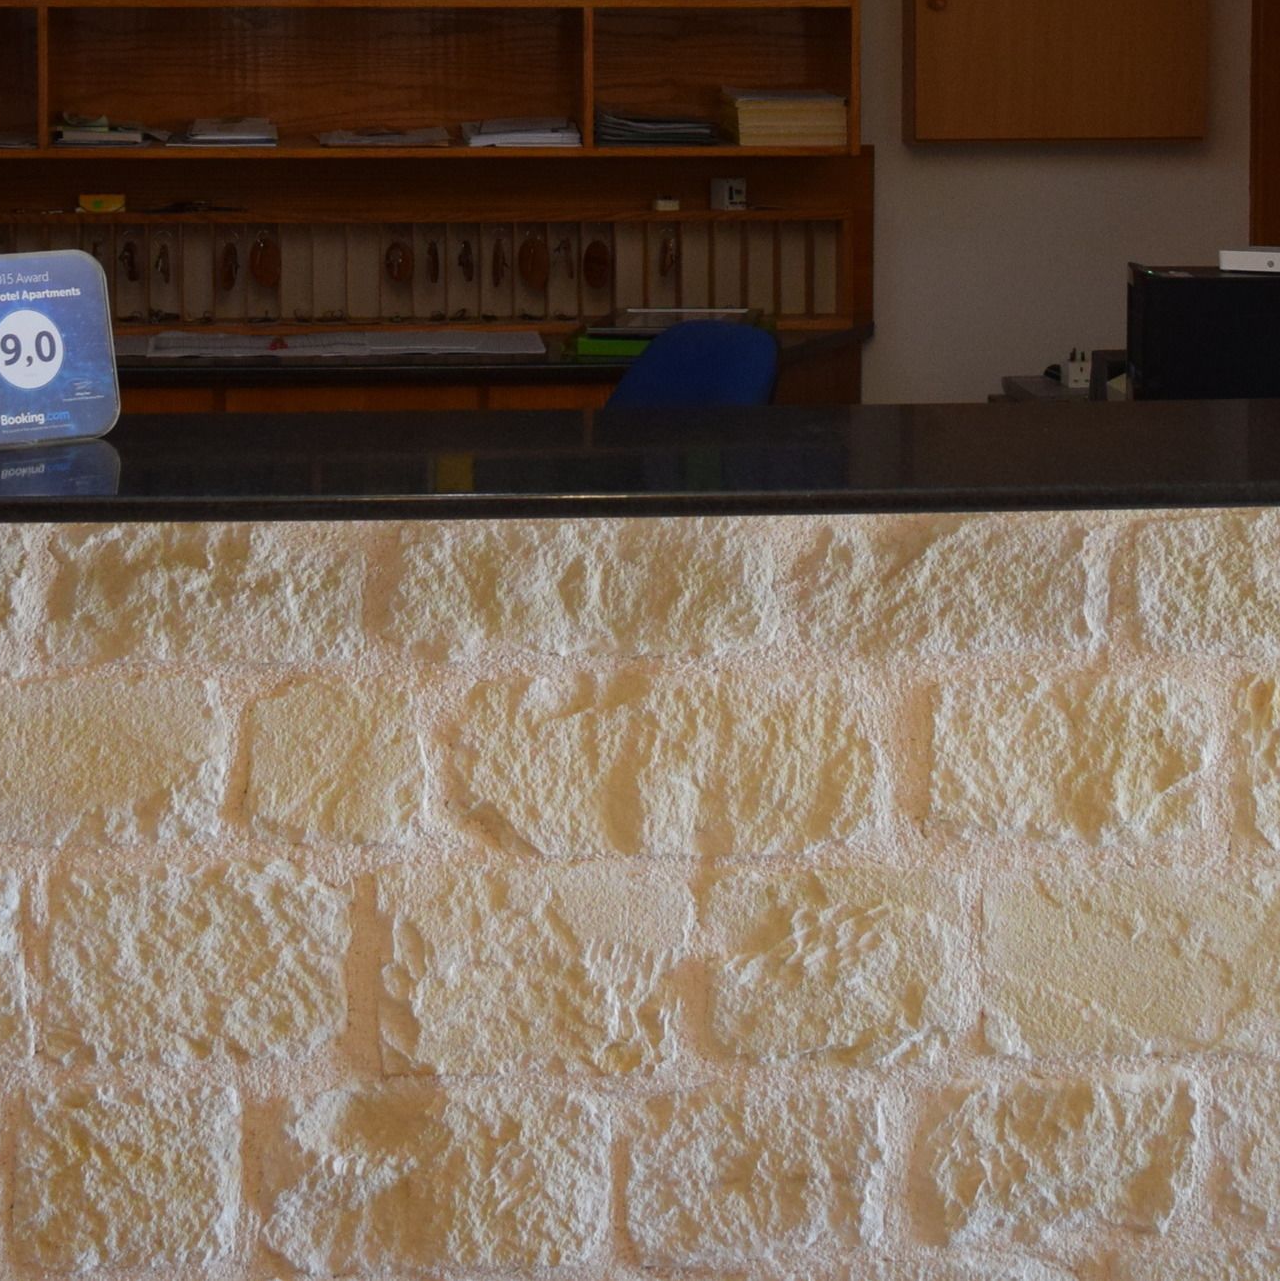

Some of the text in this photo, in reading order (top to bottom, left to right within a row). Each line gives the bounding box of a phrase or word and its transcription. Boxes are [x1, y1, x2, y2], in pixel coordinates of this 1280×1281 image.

[16, 271, 49, 284] Award
[21, 287, 81, 302] Apartments
[0, 330, 56, 367] 9,0
[0, 411, 69, 426] Booking.com
